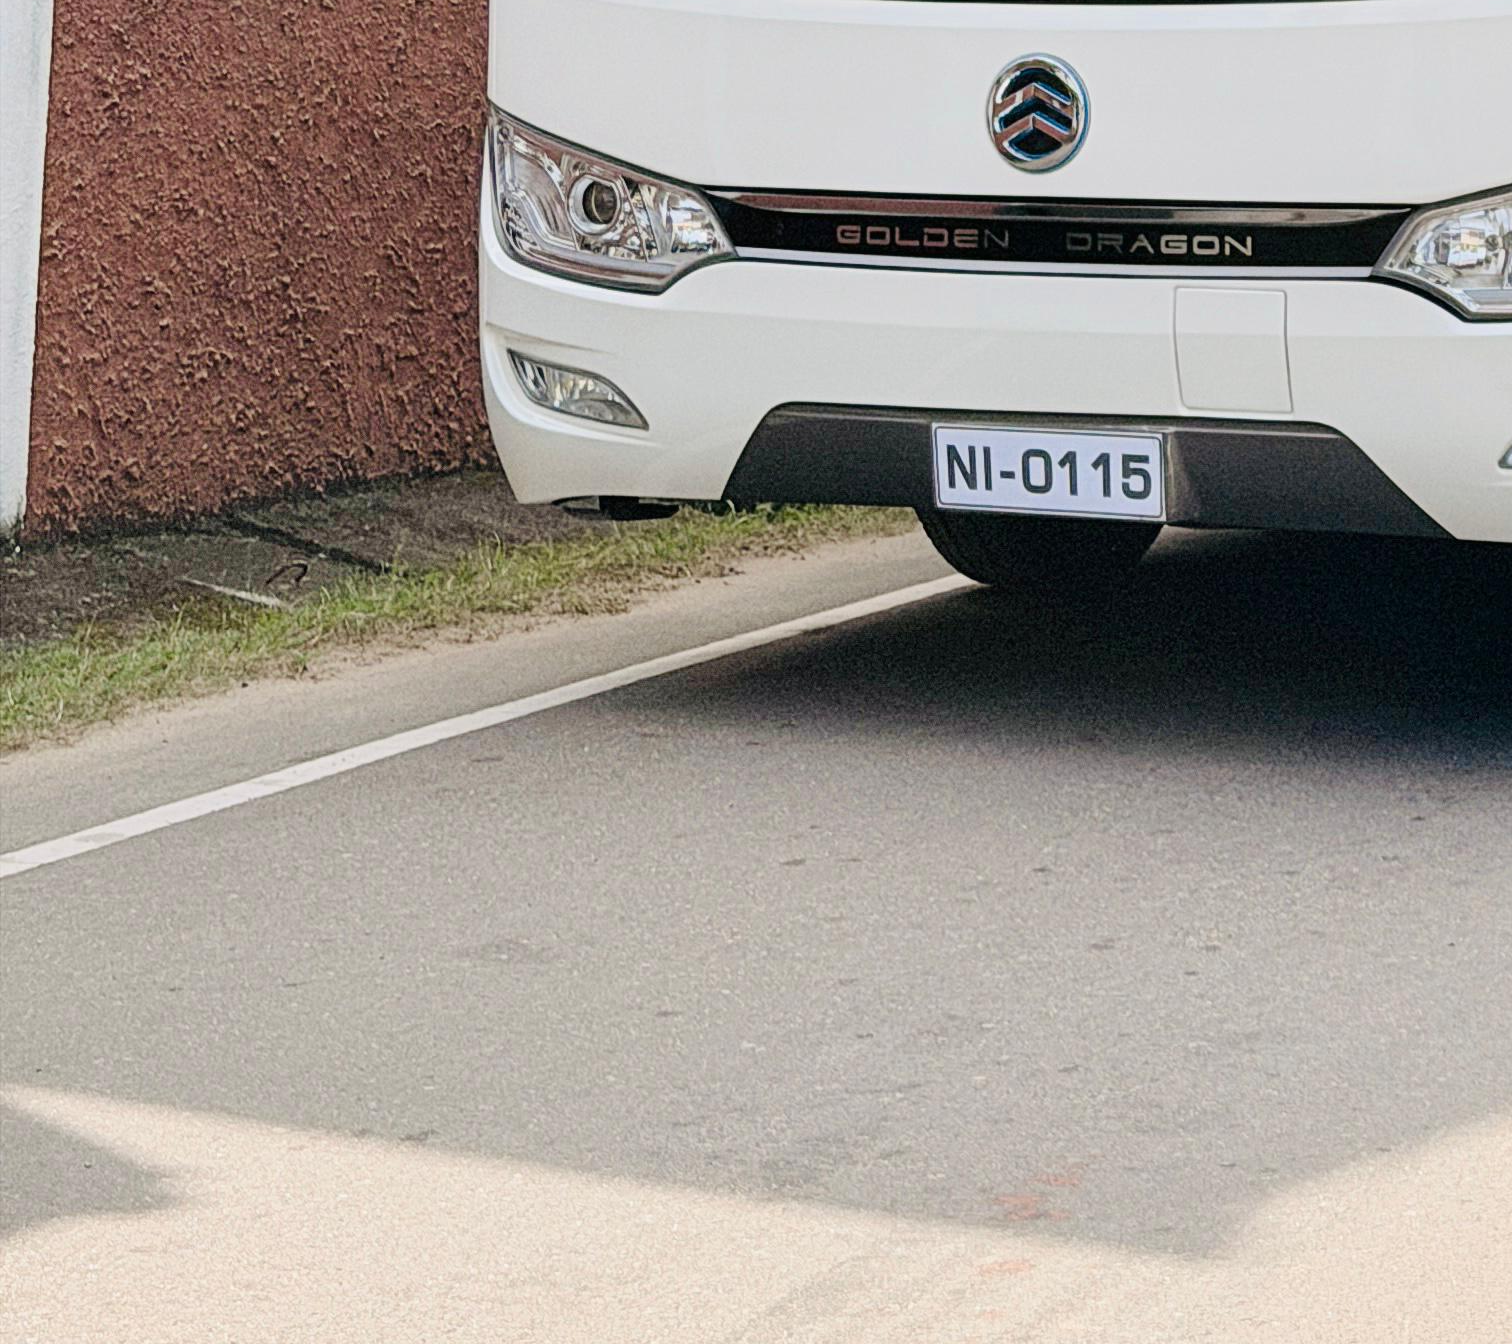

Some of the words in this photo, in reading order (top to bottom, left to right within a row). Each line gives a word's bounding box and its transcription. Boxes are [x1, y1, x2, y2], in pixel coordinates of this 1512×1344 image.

[836, 224, 1010, 249] GOLDEN
[1065, 232, 1253, 258] DRAGON
[946, 442, 1153, 501] NI-0115
